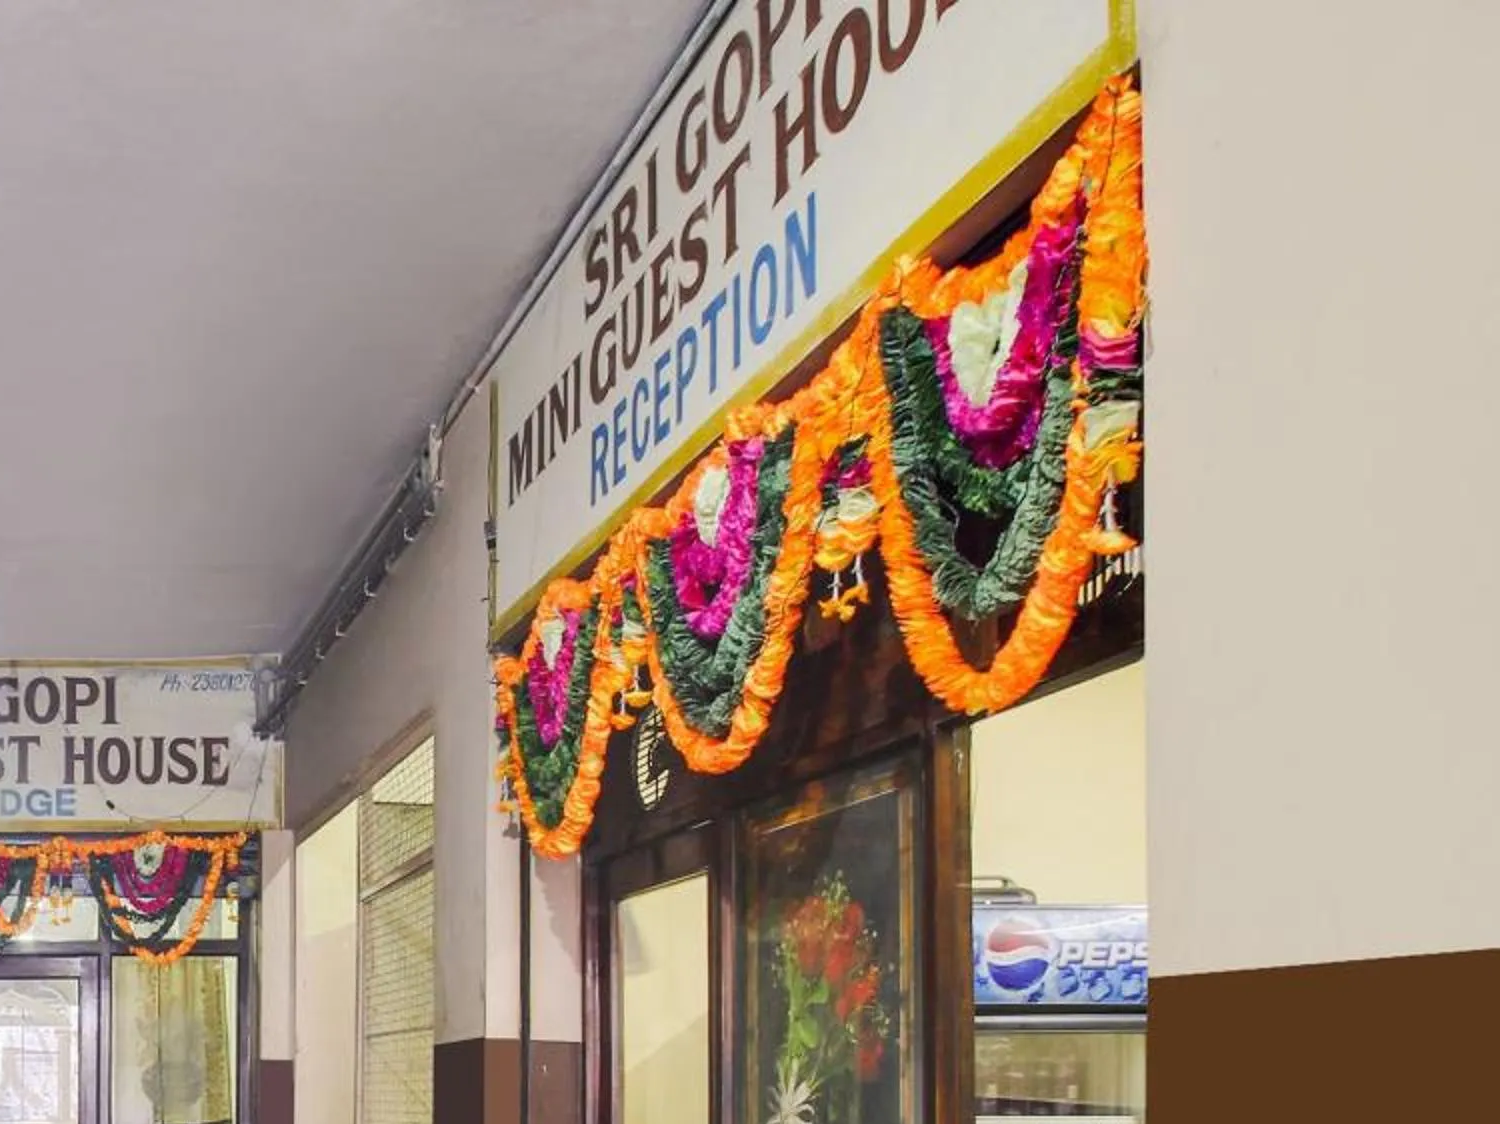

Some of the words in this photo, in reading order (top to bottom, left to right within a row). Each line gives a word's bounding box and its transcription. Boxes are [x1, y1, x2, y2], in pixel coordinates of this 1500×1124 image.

[507, 351, 582, 508] MINI
[589, 140, 751, 405] GUEST
[771, 0, 960, 209] HOU
[584, 147, 659, 323] SRI
[591, 191, 817, 506] RECEPTION
[63, 736, 230, 786] HOUSE
